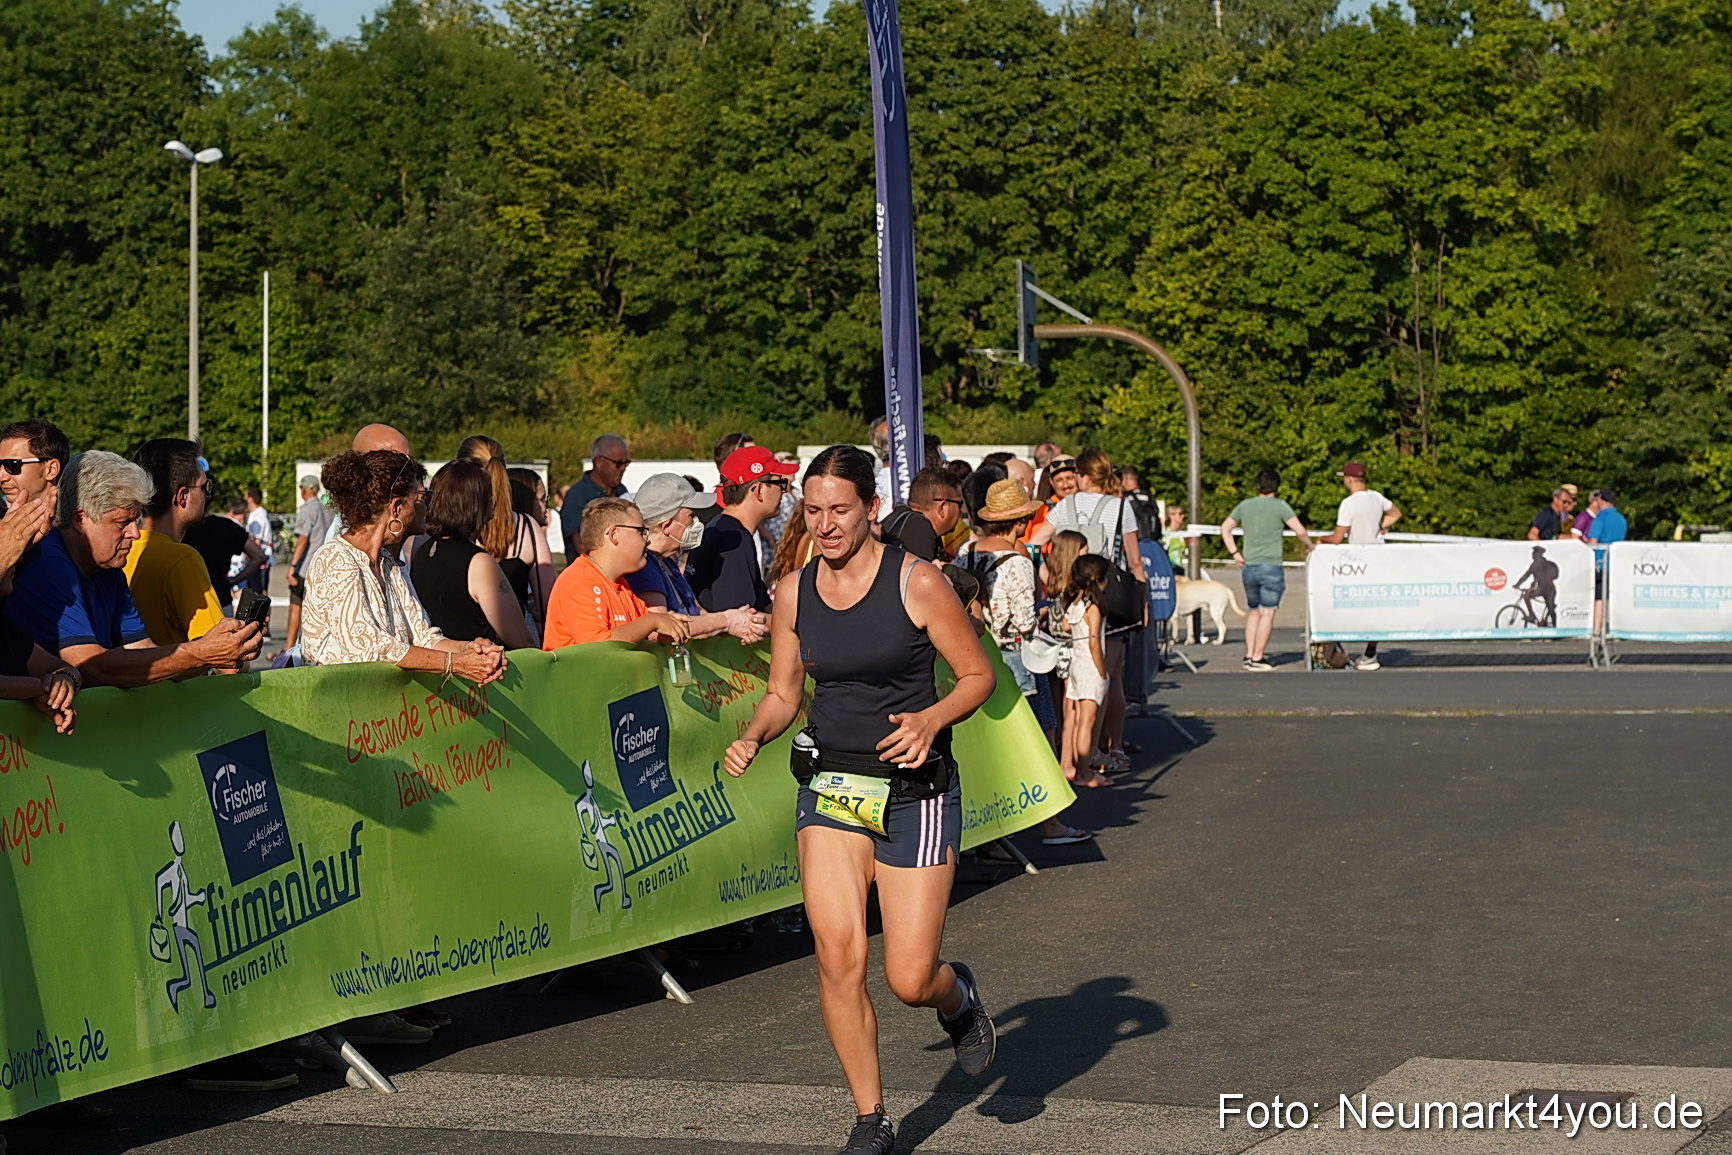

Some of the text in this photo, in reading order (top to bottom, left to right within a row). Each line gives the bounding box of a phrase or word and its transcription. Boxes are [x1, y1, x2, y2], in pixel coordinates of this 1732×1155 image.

[1149, 571, 1171, 590] cher
[1331, 563, 1368, 577] NOW
[1633, 563, 1669, 576] NOW
[1334, 583, 1487, 599] E-BIKES & FAHRRÄDER
[1635, 586, 1732, 600] E-BIKES & FAH
[346, 684, 491, 764] Gesunde Firmen
[622, 724, 660, 754] Fischer
[0, 733, 28, 774] en
[394, 719, 512, 810] laufen länger!
[628, 744, 656, 764] AUTOMOBILE
[223, 779, 268, 813] Fischer
[233, 801, 269, 825] AUTOMOBILE
[831, 793, 866, 817] 87
[0, 775, 64, 866] nger!
[616, 760, 734, 869] firmenlauf
[206, 819, 364, 962] firmenlauf
[638, 851, 690, 898] neumarkt
[222, 939, 288, 996] neumarkt
[330, 911, 551, 999] www.firmenlauf-oberpfalz.de
